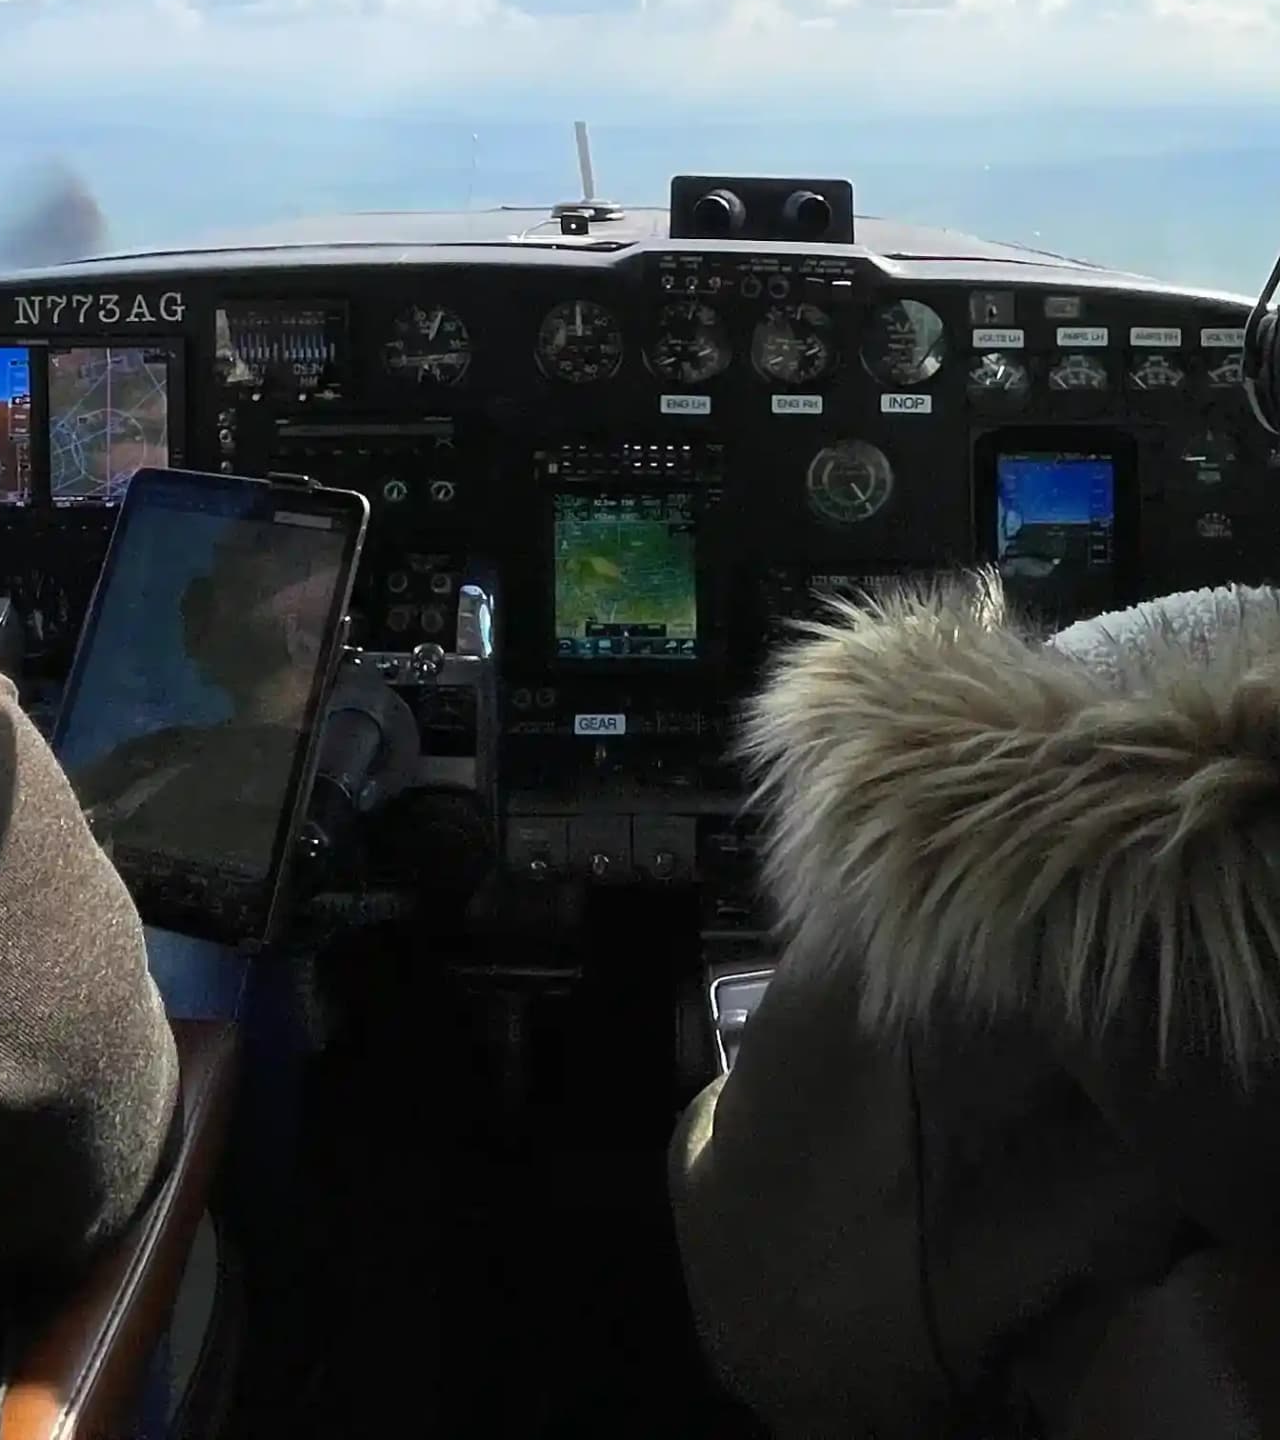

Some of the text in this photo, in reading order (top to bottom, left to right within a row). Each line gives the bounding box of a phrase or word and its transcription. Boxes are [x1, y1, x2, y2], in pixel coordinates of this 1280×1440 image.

[14, 291, 186, 325] N773AG
[666, 398, 707, 410] ENG LH
[777, 398, 818, 409] ENG RH
[888, 397, 925, 410] INOP
[579, 717, 617, 731] GEAR
